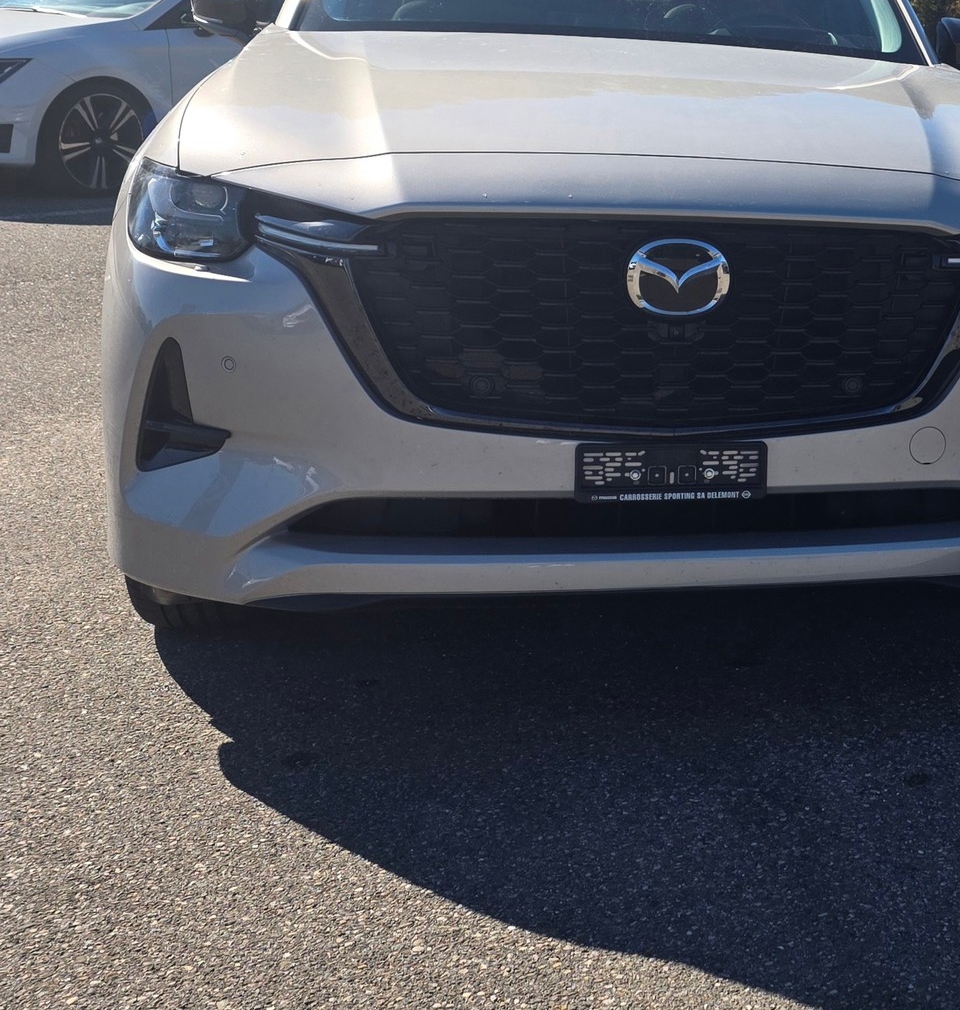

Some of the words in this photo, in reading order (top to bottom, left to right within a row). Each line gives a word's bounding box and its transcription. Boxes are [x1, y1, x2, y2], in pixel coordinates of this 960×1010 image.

[619, 493, 662, 501] CARROSSERIE
[664, 492, 695, 500] SPORTING
[706, 491, 740, 499] DELEMONT
